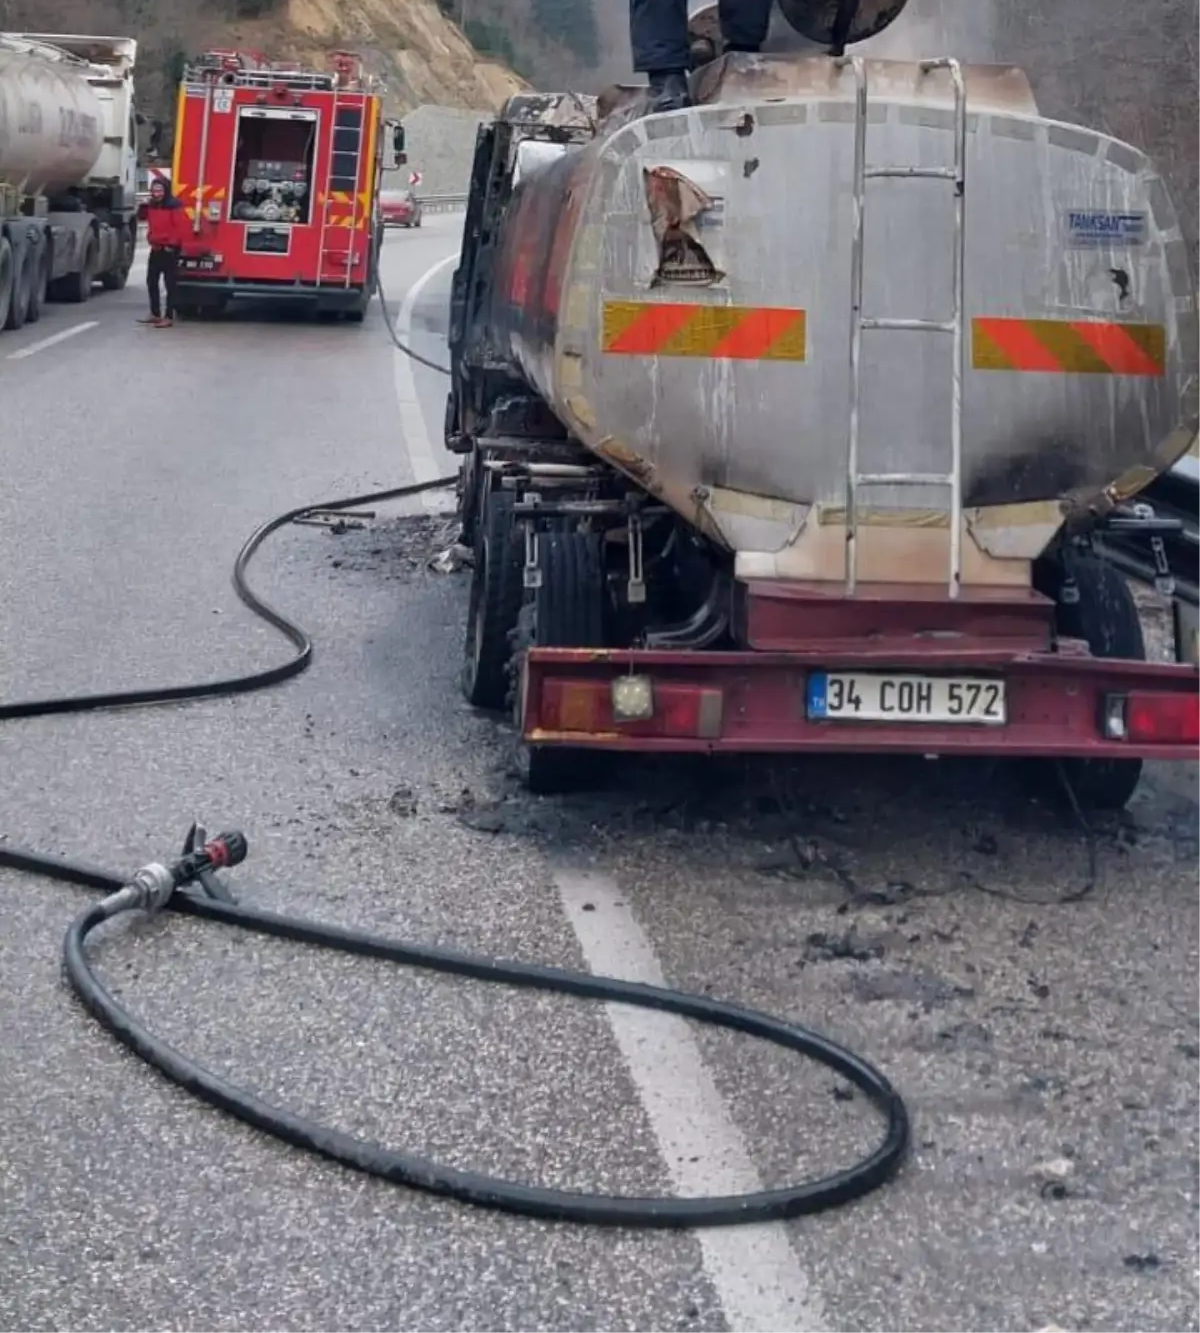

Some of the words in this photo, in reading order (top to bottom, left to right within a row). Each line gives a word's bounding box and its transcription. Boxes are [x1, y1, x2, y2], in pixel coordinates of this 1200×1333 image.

[828, 679, 862, 712] 34
[879, 681, 931, 713] COH
[947, 683, 999, 715] 572
